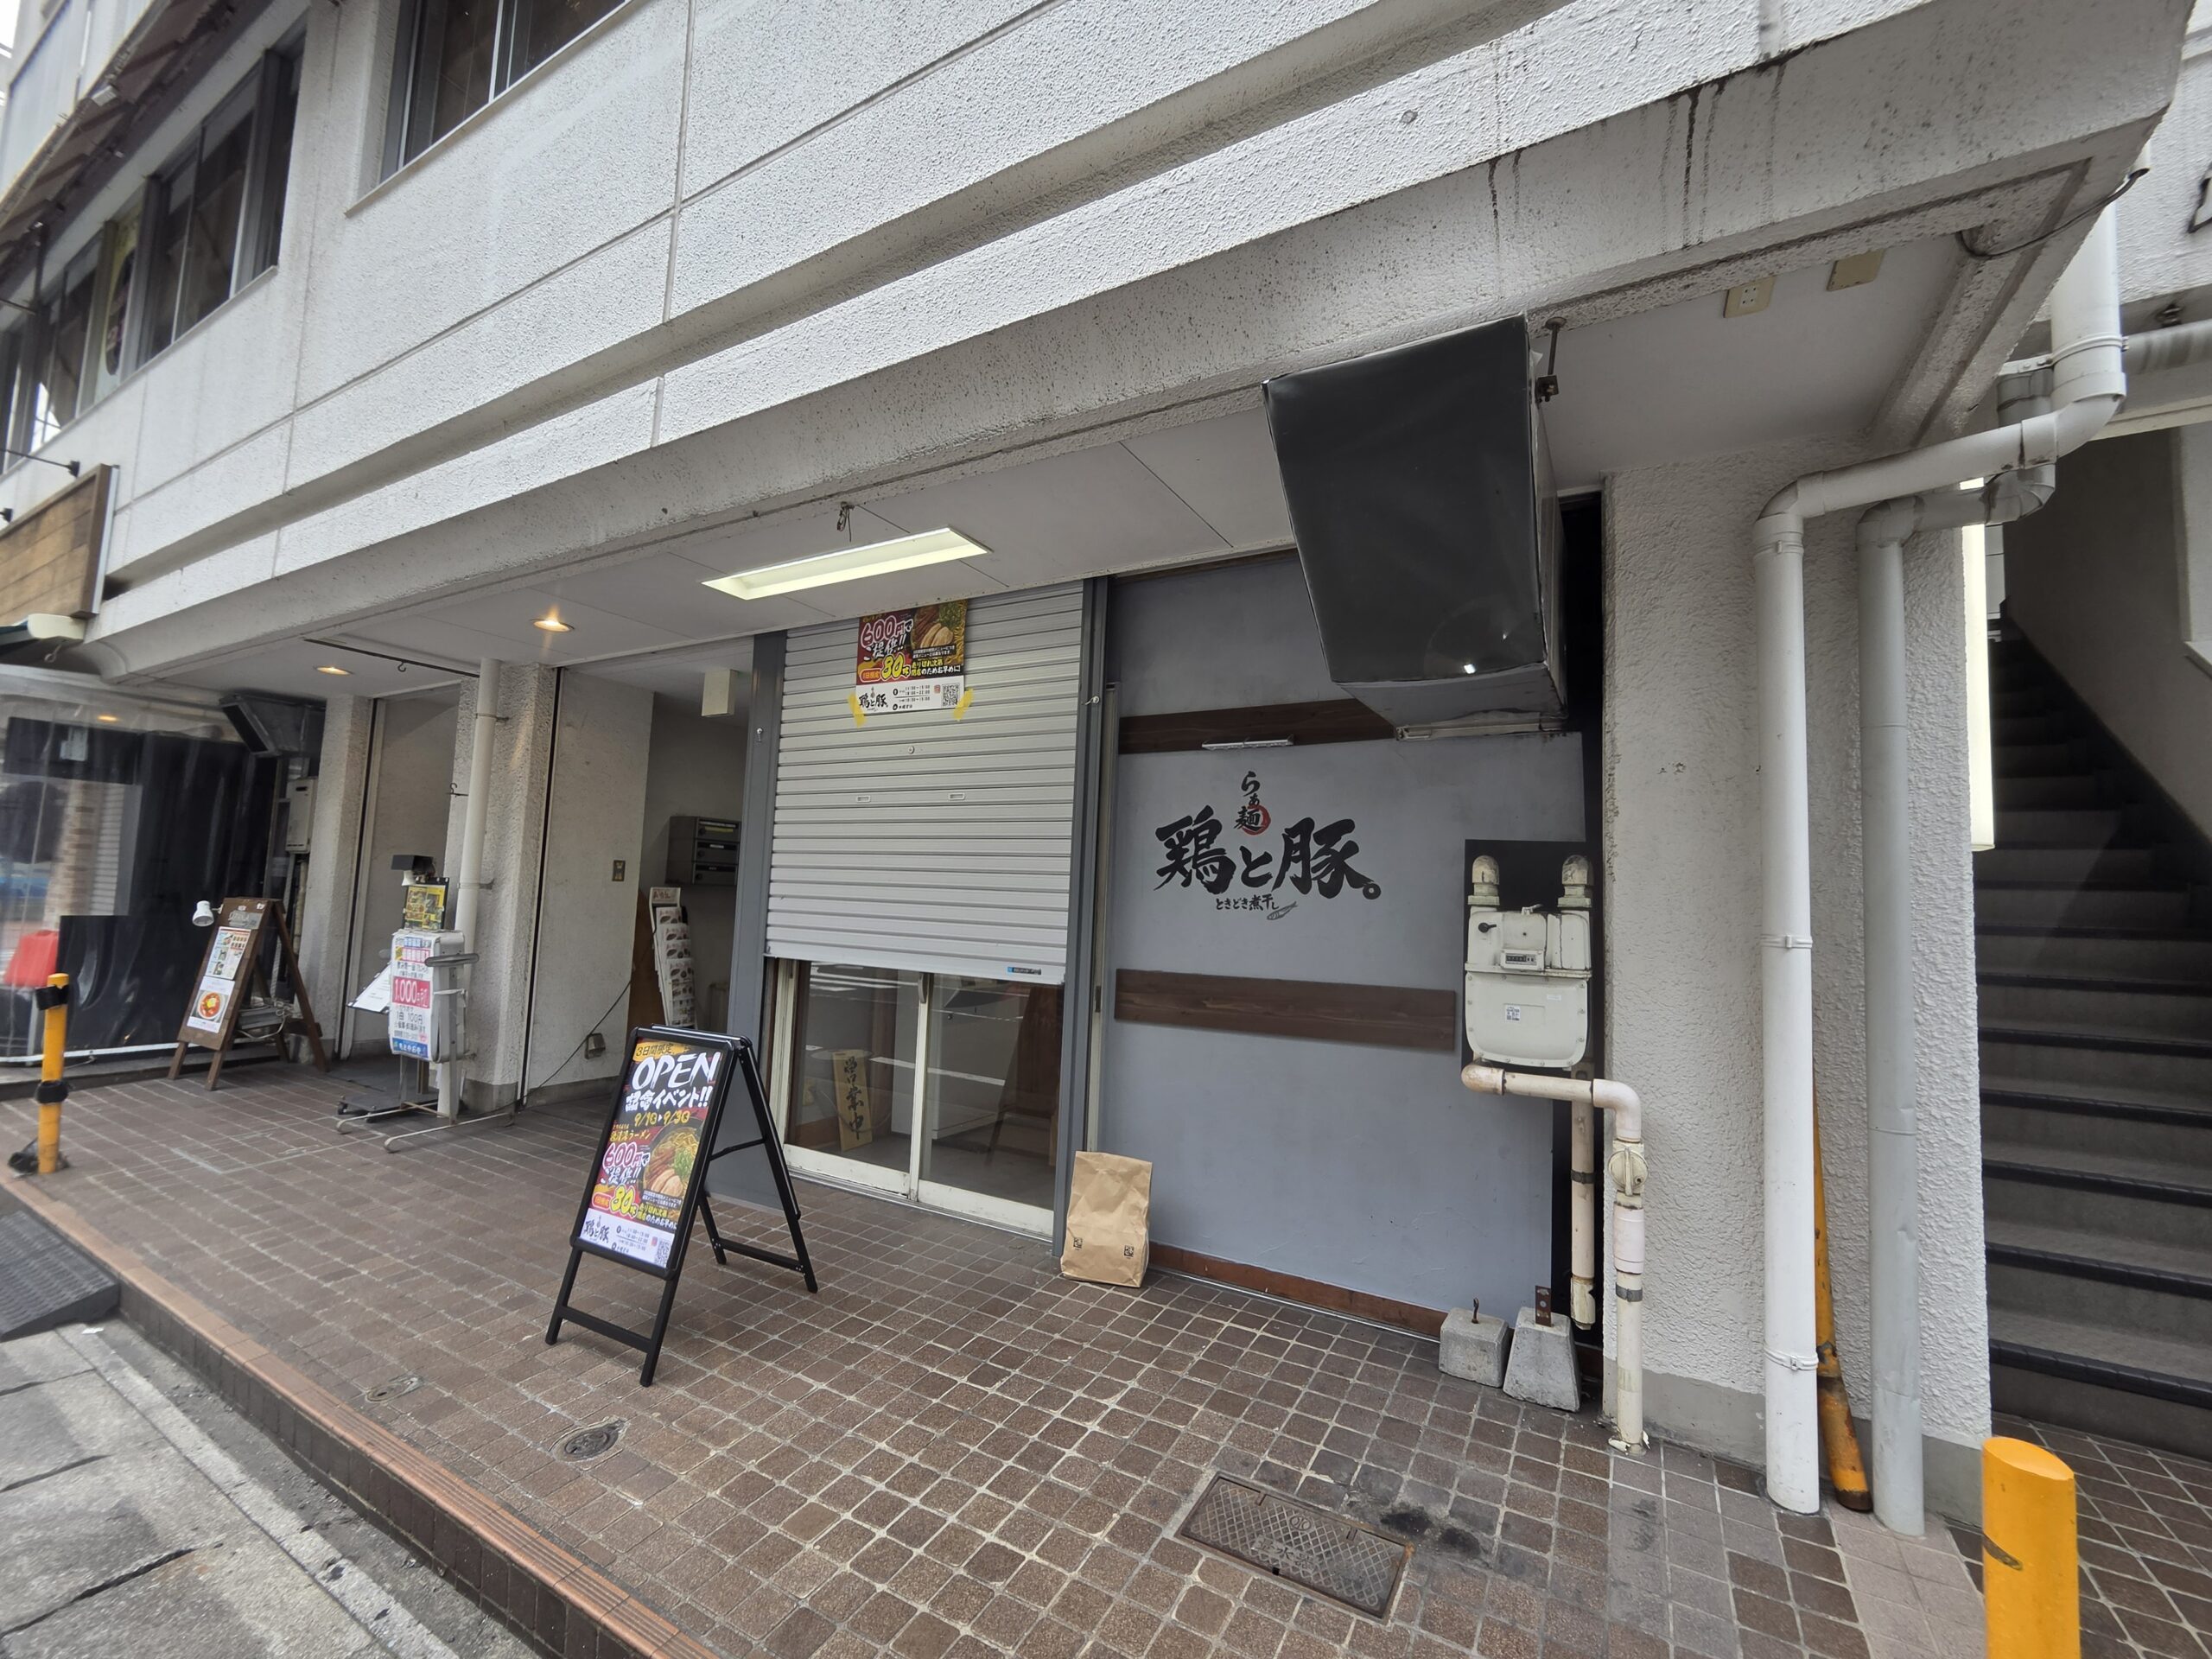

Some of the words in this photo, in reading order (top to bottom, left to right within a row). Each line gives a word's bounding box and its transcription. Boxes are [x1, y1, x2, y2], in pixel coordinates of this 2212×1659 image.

[1234, 771, 1261, 831] らぁ麺
[1216, 893, 1280, 911] ときどき煮干し
[632, 1051, 721, 1090] OPEN
[843, 1056, 865, 1141] 営業中
